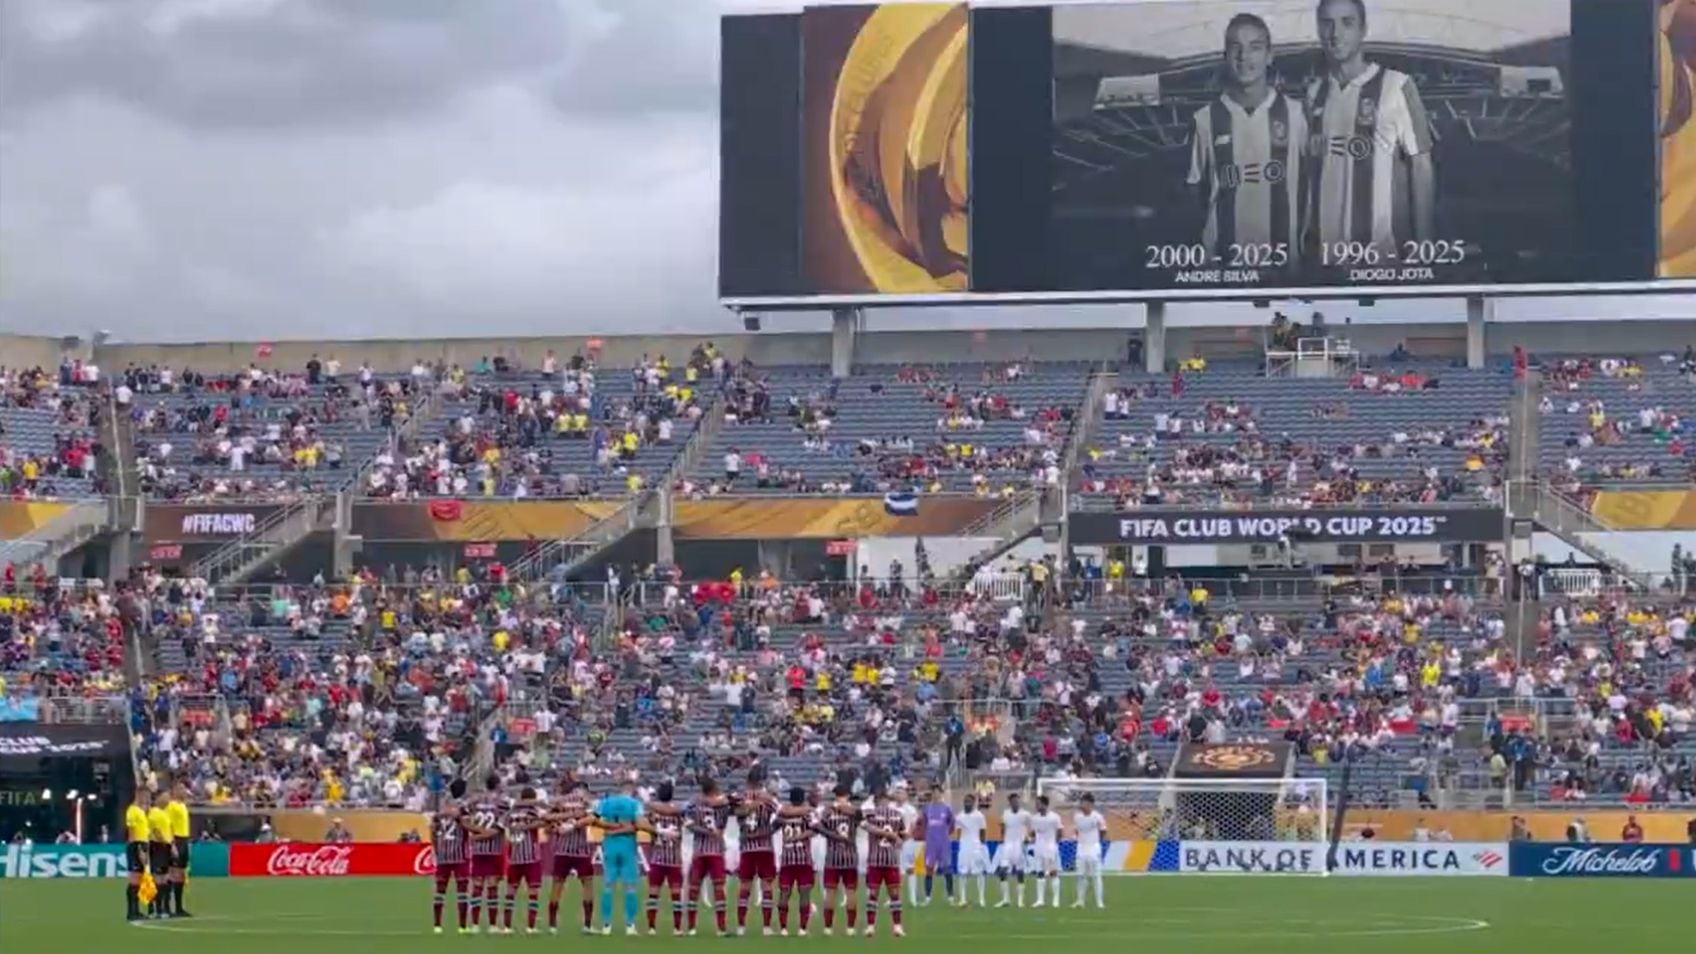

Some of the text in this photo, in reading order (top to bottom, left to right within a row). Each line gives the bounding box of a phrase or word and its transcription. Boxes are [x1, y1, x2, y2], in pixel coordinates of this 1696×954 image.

[1146, 244, 1205, 268] 2000
[1229, 242, 1288, 267] 2025
[1322, 241, 1379, 266] 1996
[1403, 239, 1465, 264] 2025
[1223, 270, 1260, 283] SILVA
[1349, 267, 1434, 281] DIOGO JOTA
[182, 513, 256, 534] #FIFACWC
[1120, 519, 1170, 537] FIFA
[1173, 518, 1232, 537] CLUB
[1238, 517, 1322, 536] WORD
[1326, 516, 1373, 536] CUP
[267, 844, 353, 875] Coca-Cola
[1185, 849, 1262, 870] BANK
[1276, 849, 1313, 870] OF
[1542, 847, 1661, 875] Michelob
